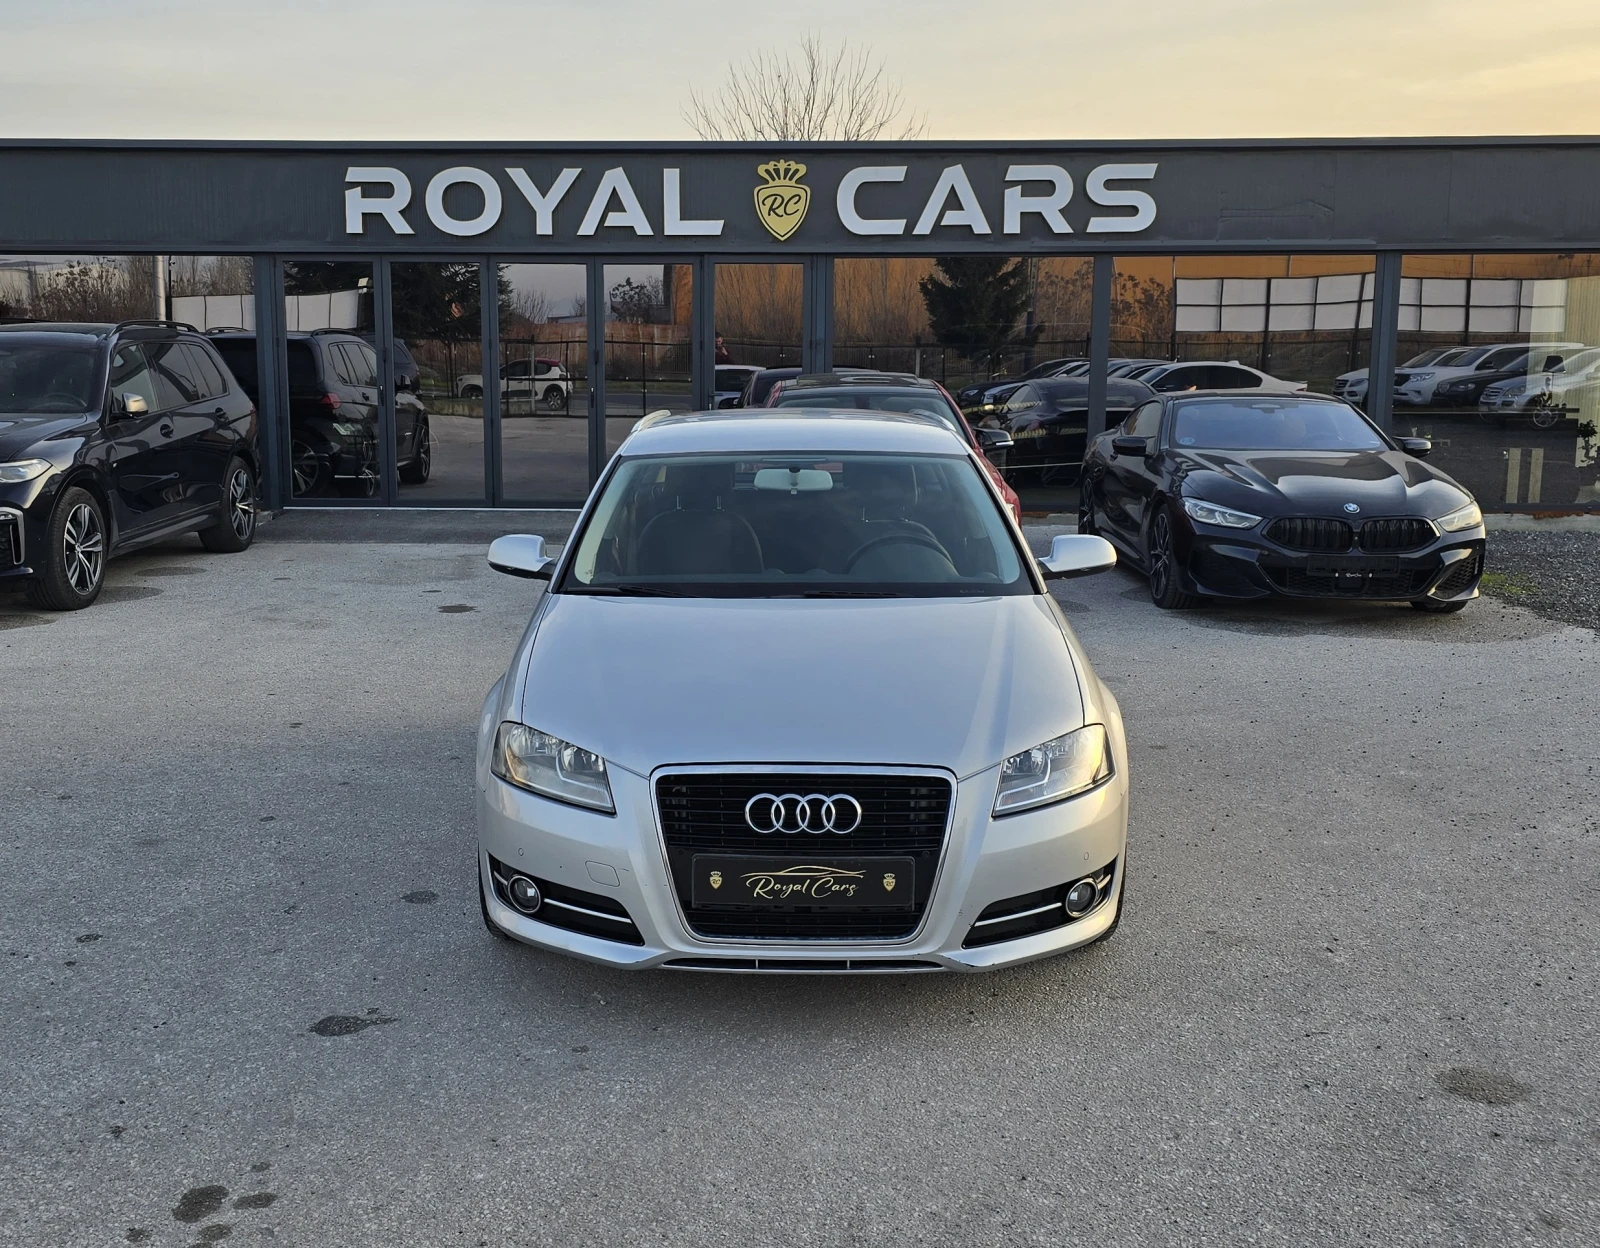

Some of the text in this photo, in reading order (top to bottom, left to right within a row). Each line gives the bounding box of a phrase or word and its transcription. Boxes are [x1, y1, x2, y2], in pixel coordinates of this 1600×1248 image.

[345, 162, 1159, 237] ROYAL CARS
[761, 193, 802, 218] RC
[745, 875, 859, 899] Royal Cars
